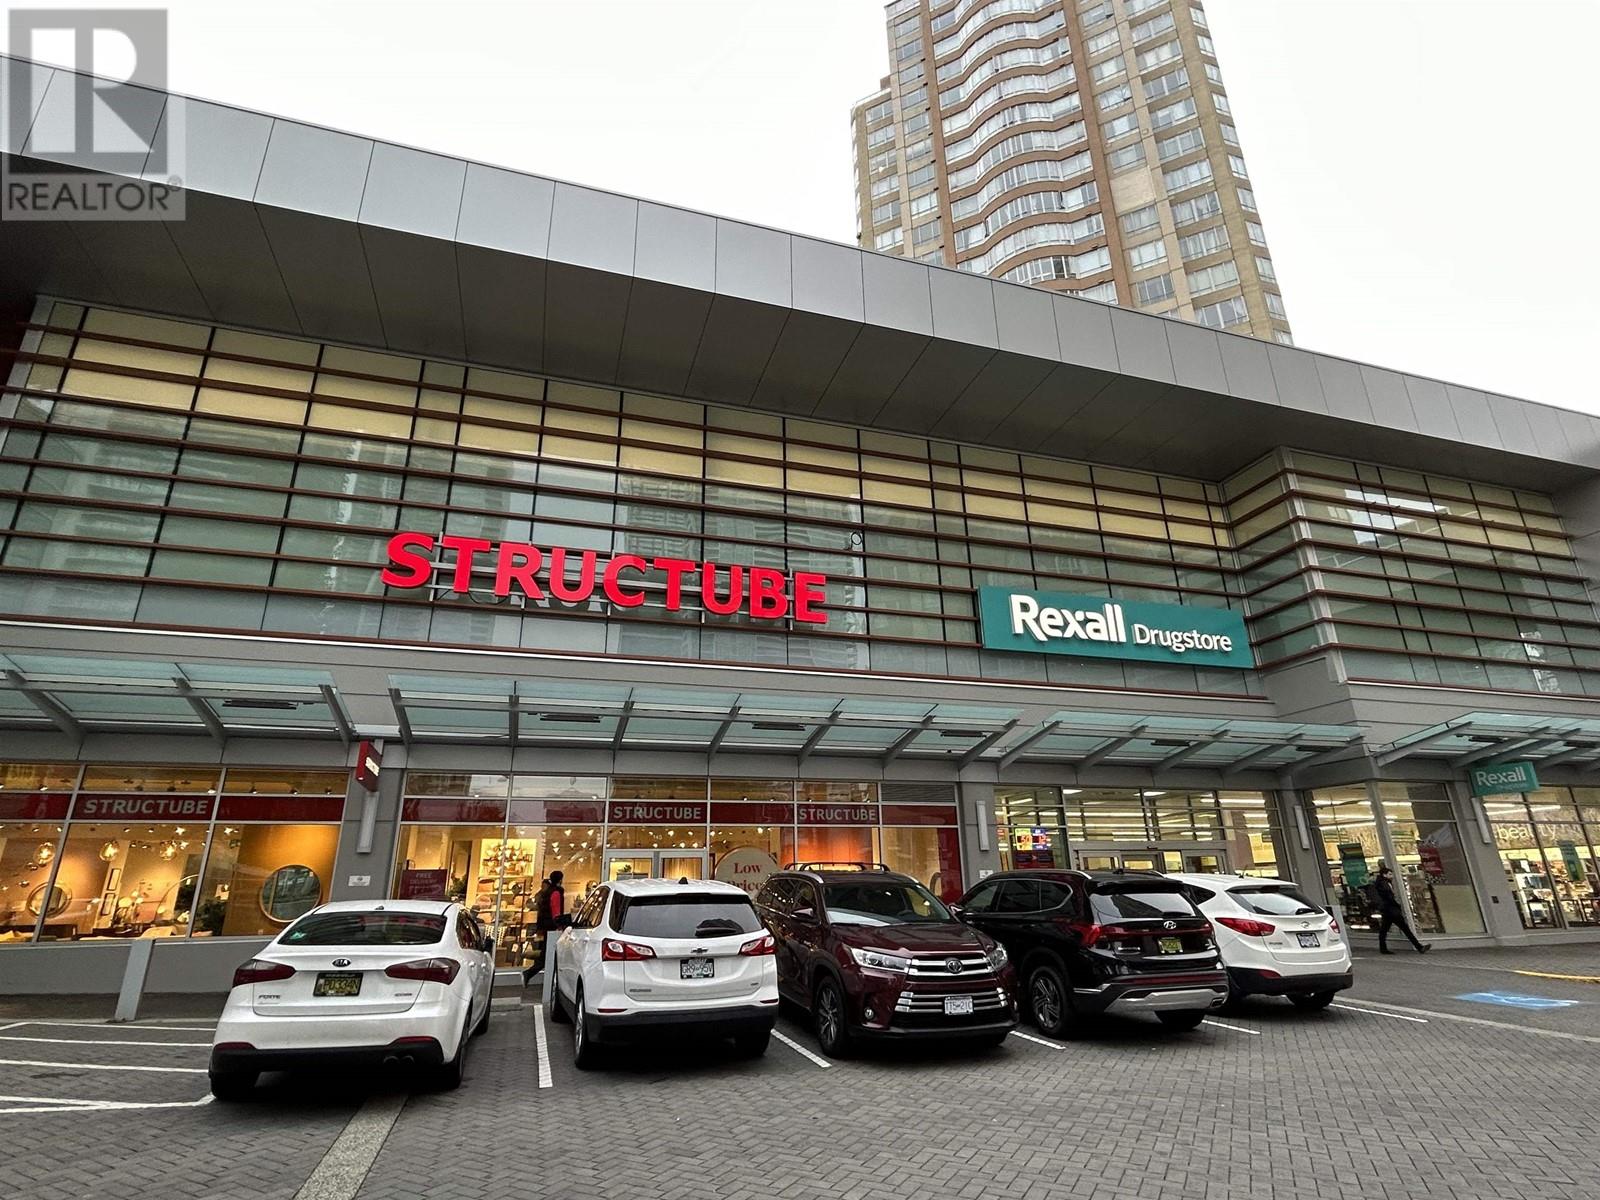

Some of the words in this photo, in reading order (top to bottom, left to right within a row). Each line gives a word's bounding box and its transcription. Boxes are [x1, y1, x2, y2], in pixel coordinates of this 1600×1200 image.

[380, 531, 828, 624] STRUCTUBE
[1010, 593, 1127, 643] Rexall
[1131, 623, 1233, 653] Drugstore
[1475, 766, 1527, 786] Rexall
[83, 799, 208, 814] STRUCTUBE
[613, 806, 702, 819] STRUCTUBE
[799, 808, 877, 820] STRUCTUBE
[734, 862, 762, 874] Low
